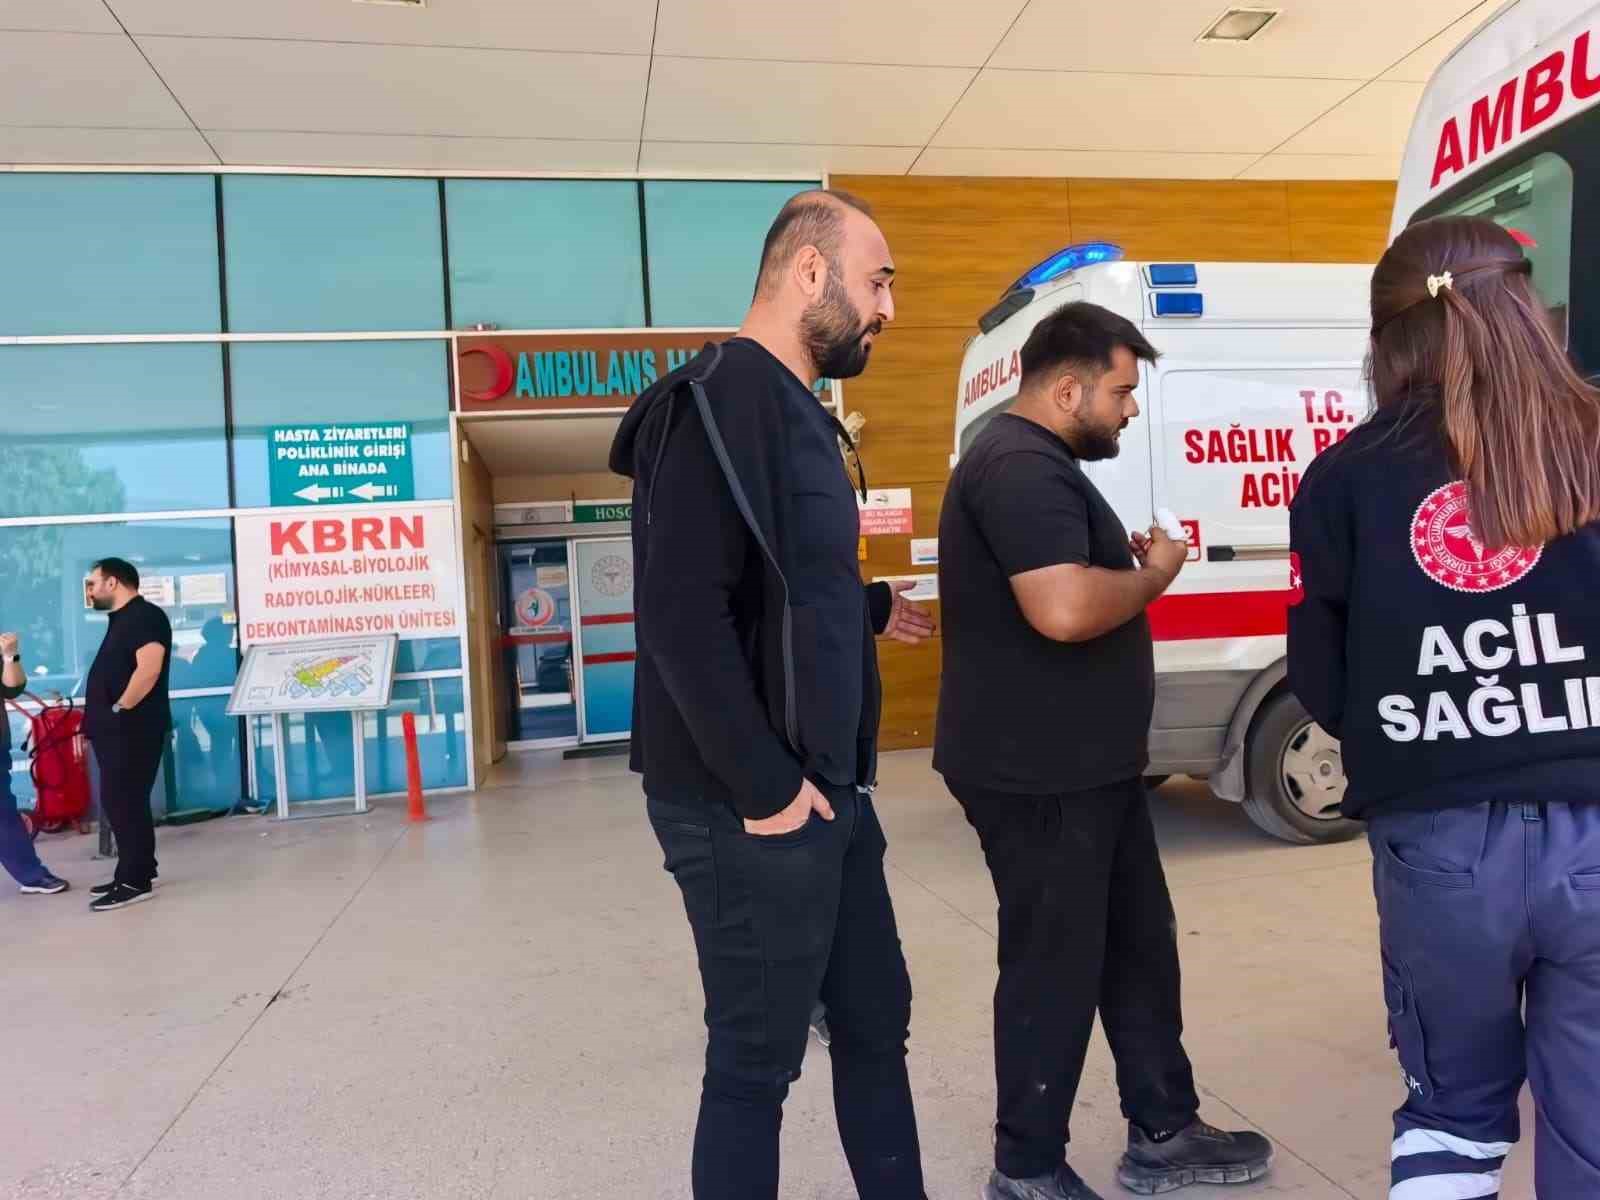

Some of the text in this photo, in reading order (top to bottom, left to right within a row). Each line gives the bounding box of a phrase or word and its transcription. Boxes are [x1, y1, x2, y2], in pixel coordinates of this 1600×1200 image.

[1430, 30, 1600, 189] AMBU
[515, 349, 657, 398] AMBULANS
[963, 349, 1020, 408] AMBULA
[1299, 390, 1354, 424] T.C.
[274, 424, 407, 442] HASTA ZİYARETLERİ
[1184, 423, 1296, 464] SAĞLIK
[277, 441, 406, 460] POLİKLİNİK GİRİŞİ
[298, 460, 387, 477] ANA BİNADA
[269, 515, 425, 556] KBRN
[268, 554, 430, 583] (KİMYASAL-BİYOLOJİK
[264, 582, 436, 609] RADYOLOJİK-NÜKLEER)
[246, 613, 394, 639] DEKONTAMİNASYON
[1417, 603, 1585, 676] ACİL
